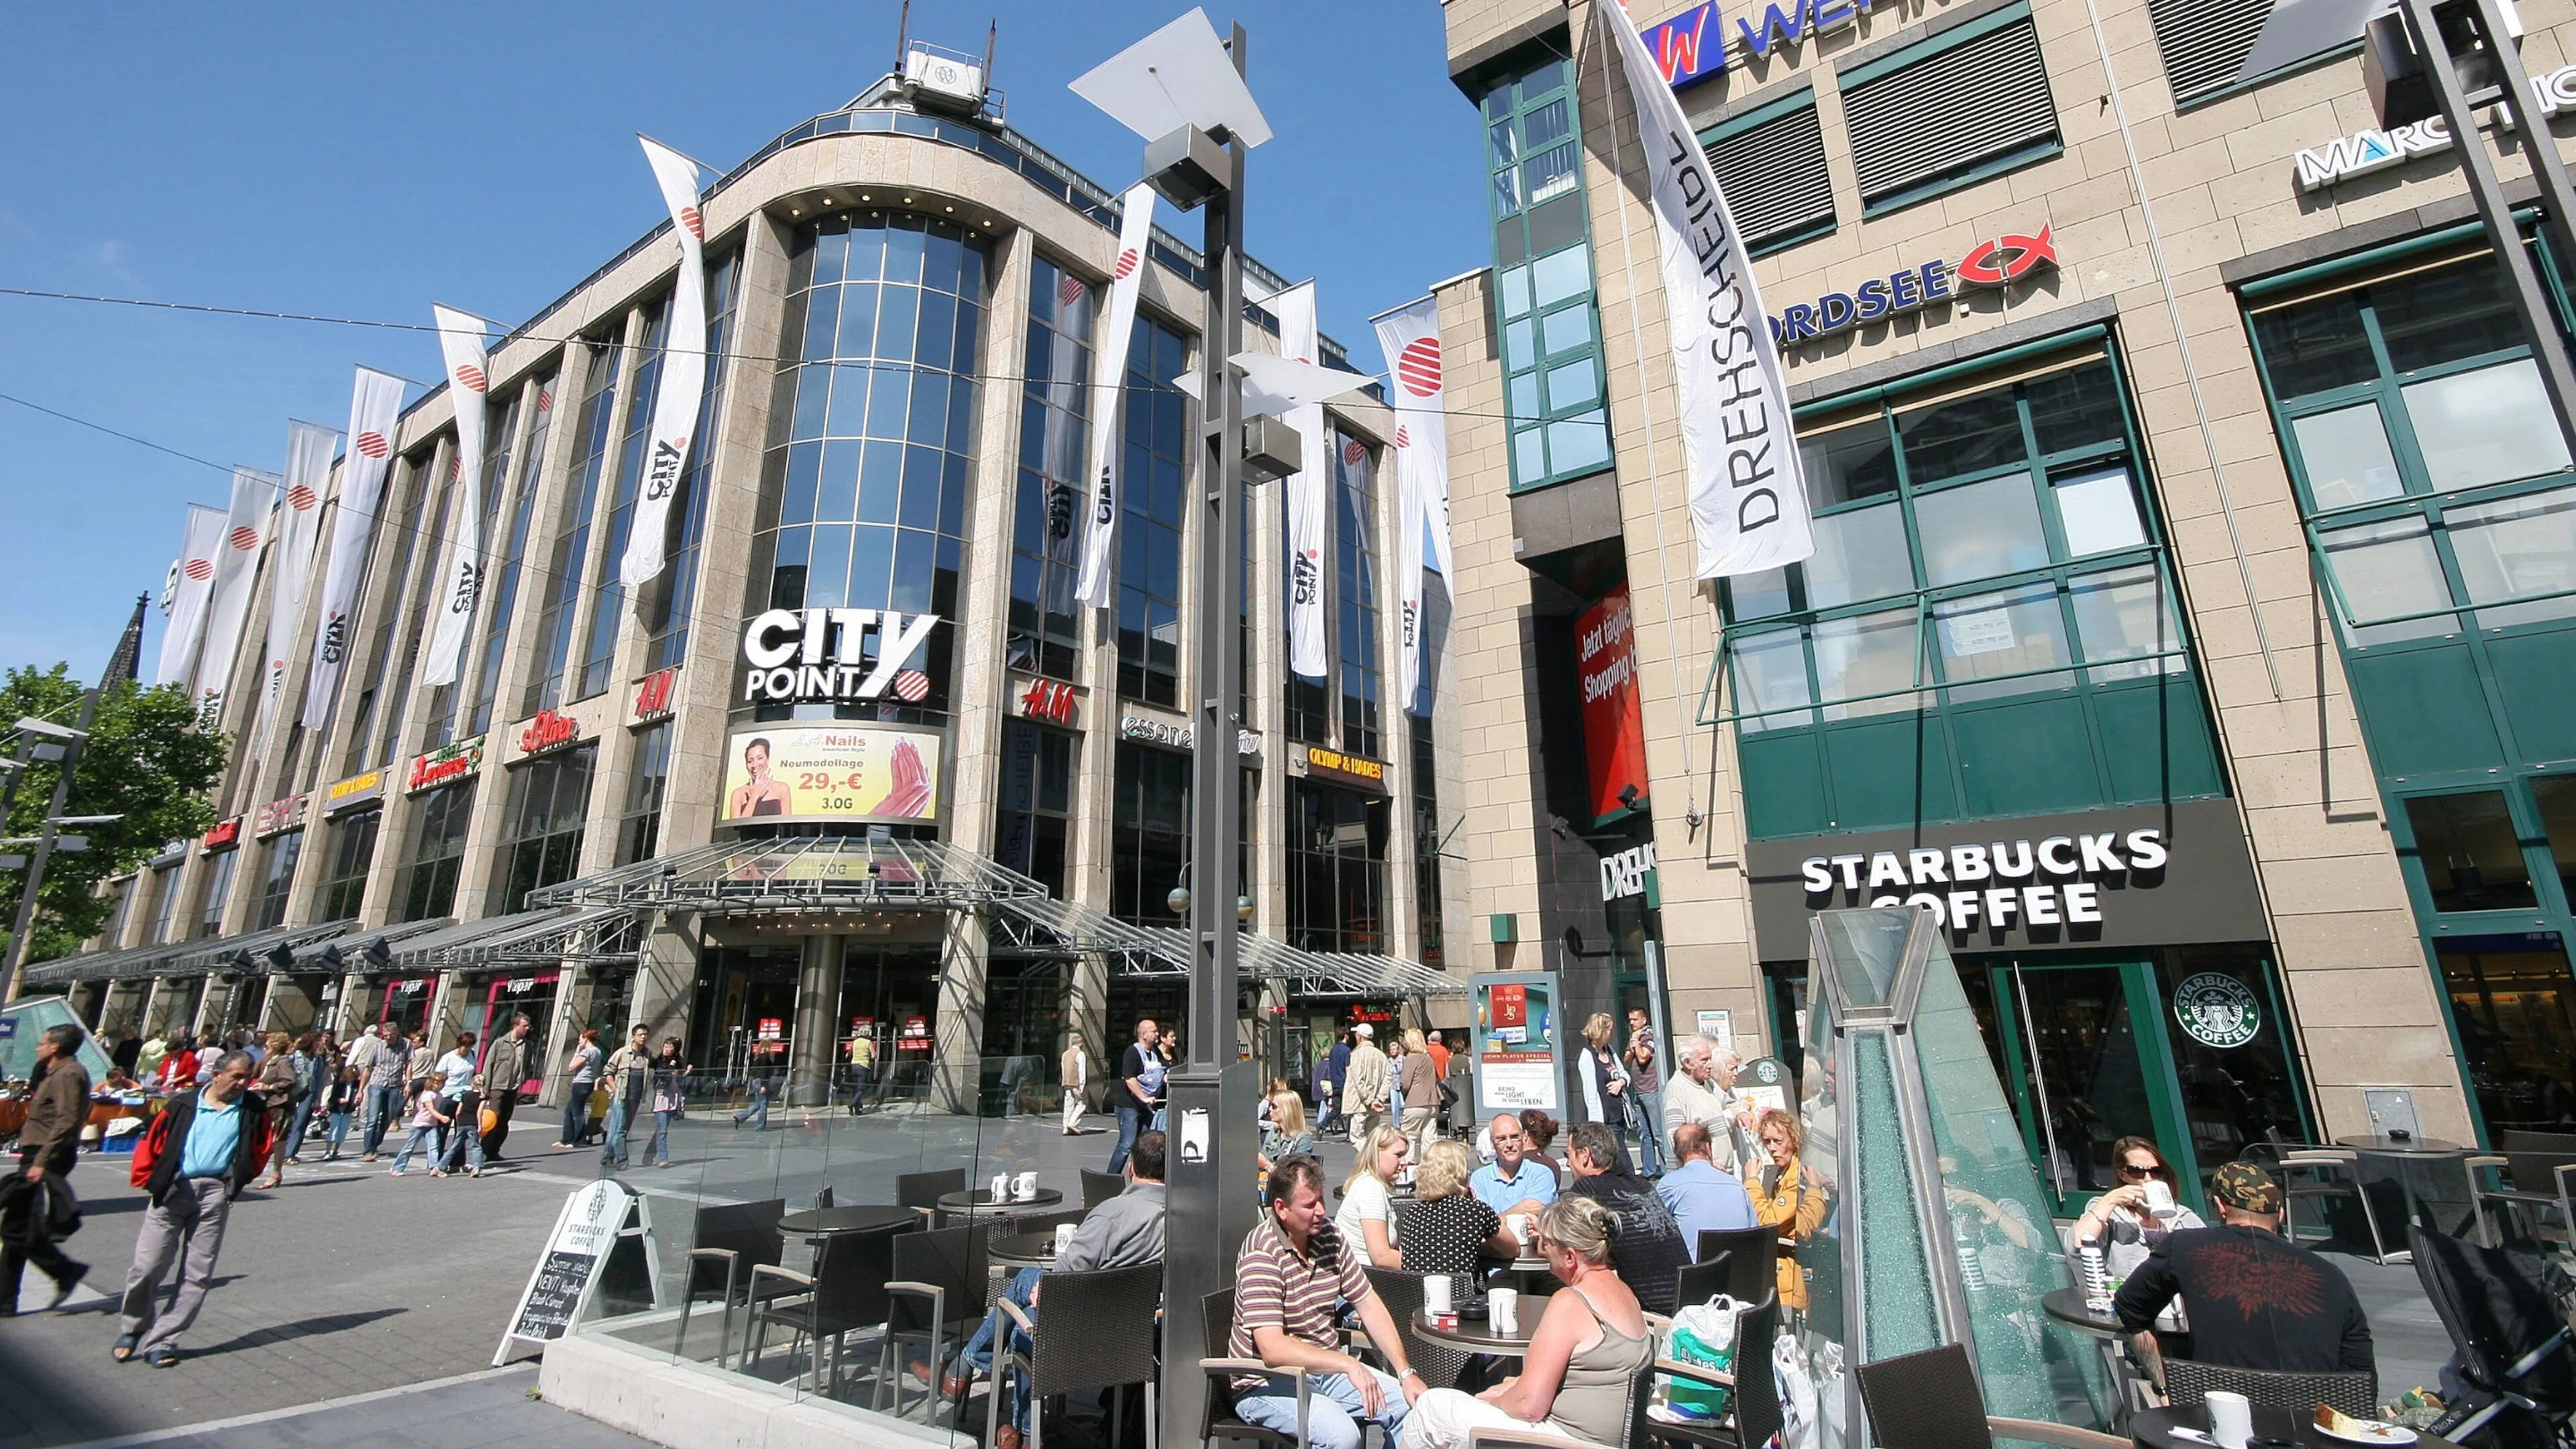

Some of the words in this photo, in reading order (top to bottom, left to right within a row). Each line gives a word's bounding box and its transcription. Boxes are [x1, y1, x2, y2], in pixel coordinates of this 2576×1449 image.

[1768, 258, 1951, 345] RDSEE
[647, 439, 681, 501] CITY
[451, 561, 474, 614] CITY
[1295, 551, 1317, 604] CITY
[1308, 574, 1317, 605] POINT
[745, 607, 941, 698] CITY
[1581, 623, 1603, 662] Jetzt
[1603, 603, 1631, 645] täglic
[745, 666, 864, 702] POINT
[1585, 656, 1629, 704] Shopping
[1022, 678, 1073, 725] H&M
[825, 735, 866, 747] Nails
[780, 759, 864, 769] Neumodellage
[798, 772, 863, 793] 29,-€
[1309, 747, 1342, 769] OLYMP
[1343, 756, 1350, 771] &
[1351, 757, 1382, 780] HADES
[822, 797, 853, 809] 3.OG
[1801, 828, 2168, 894] STARBUCKS
[2178, 975, 2254, 1008] STARBUCKS
[2191, 1024, 2252, 1044] COFFEE
